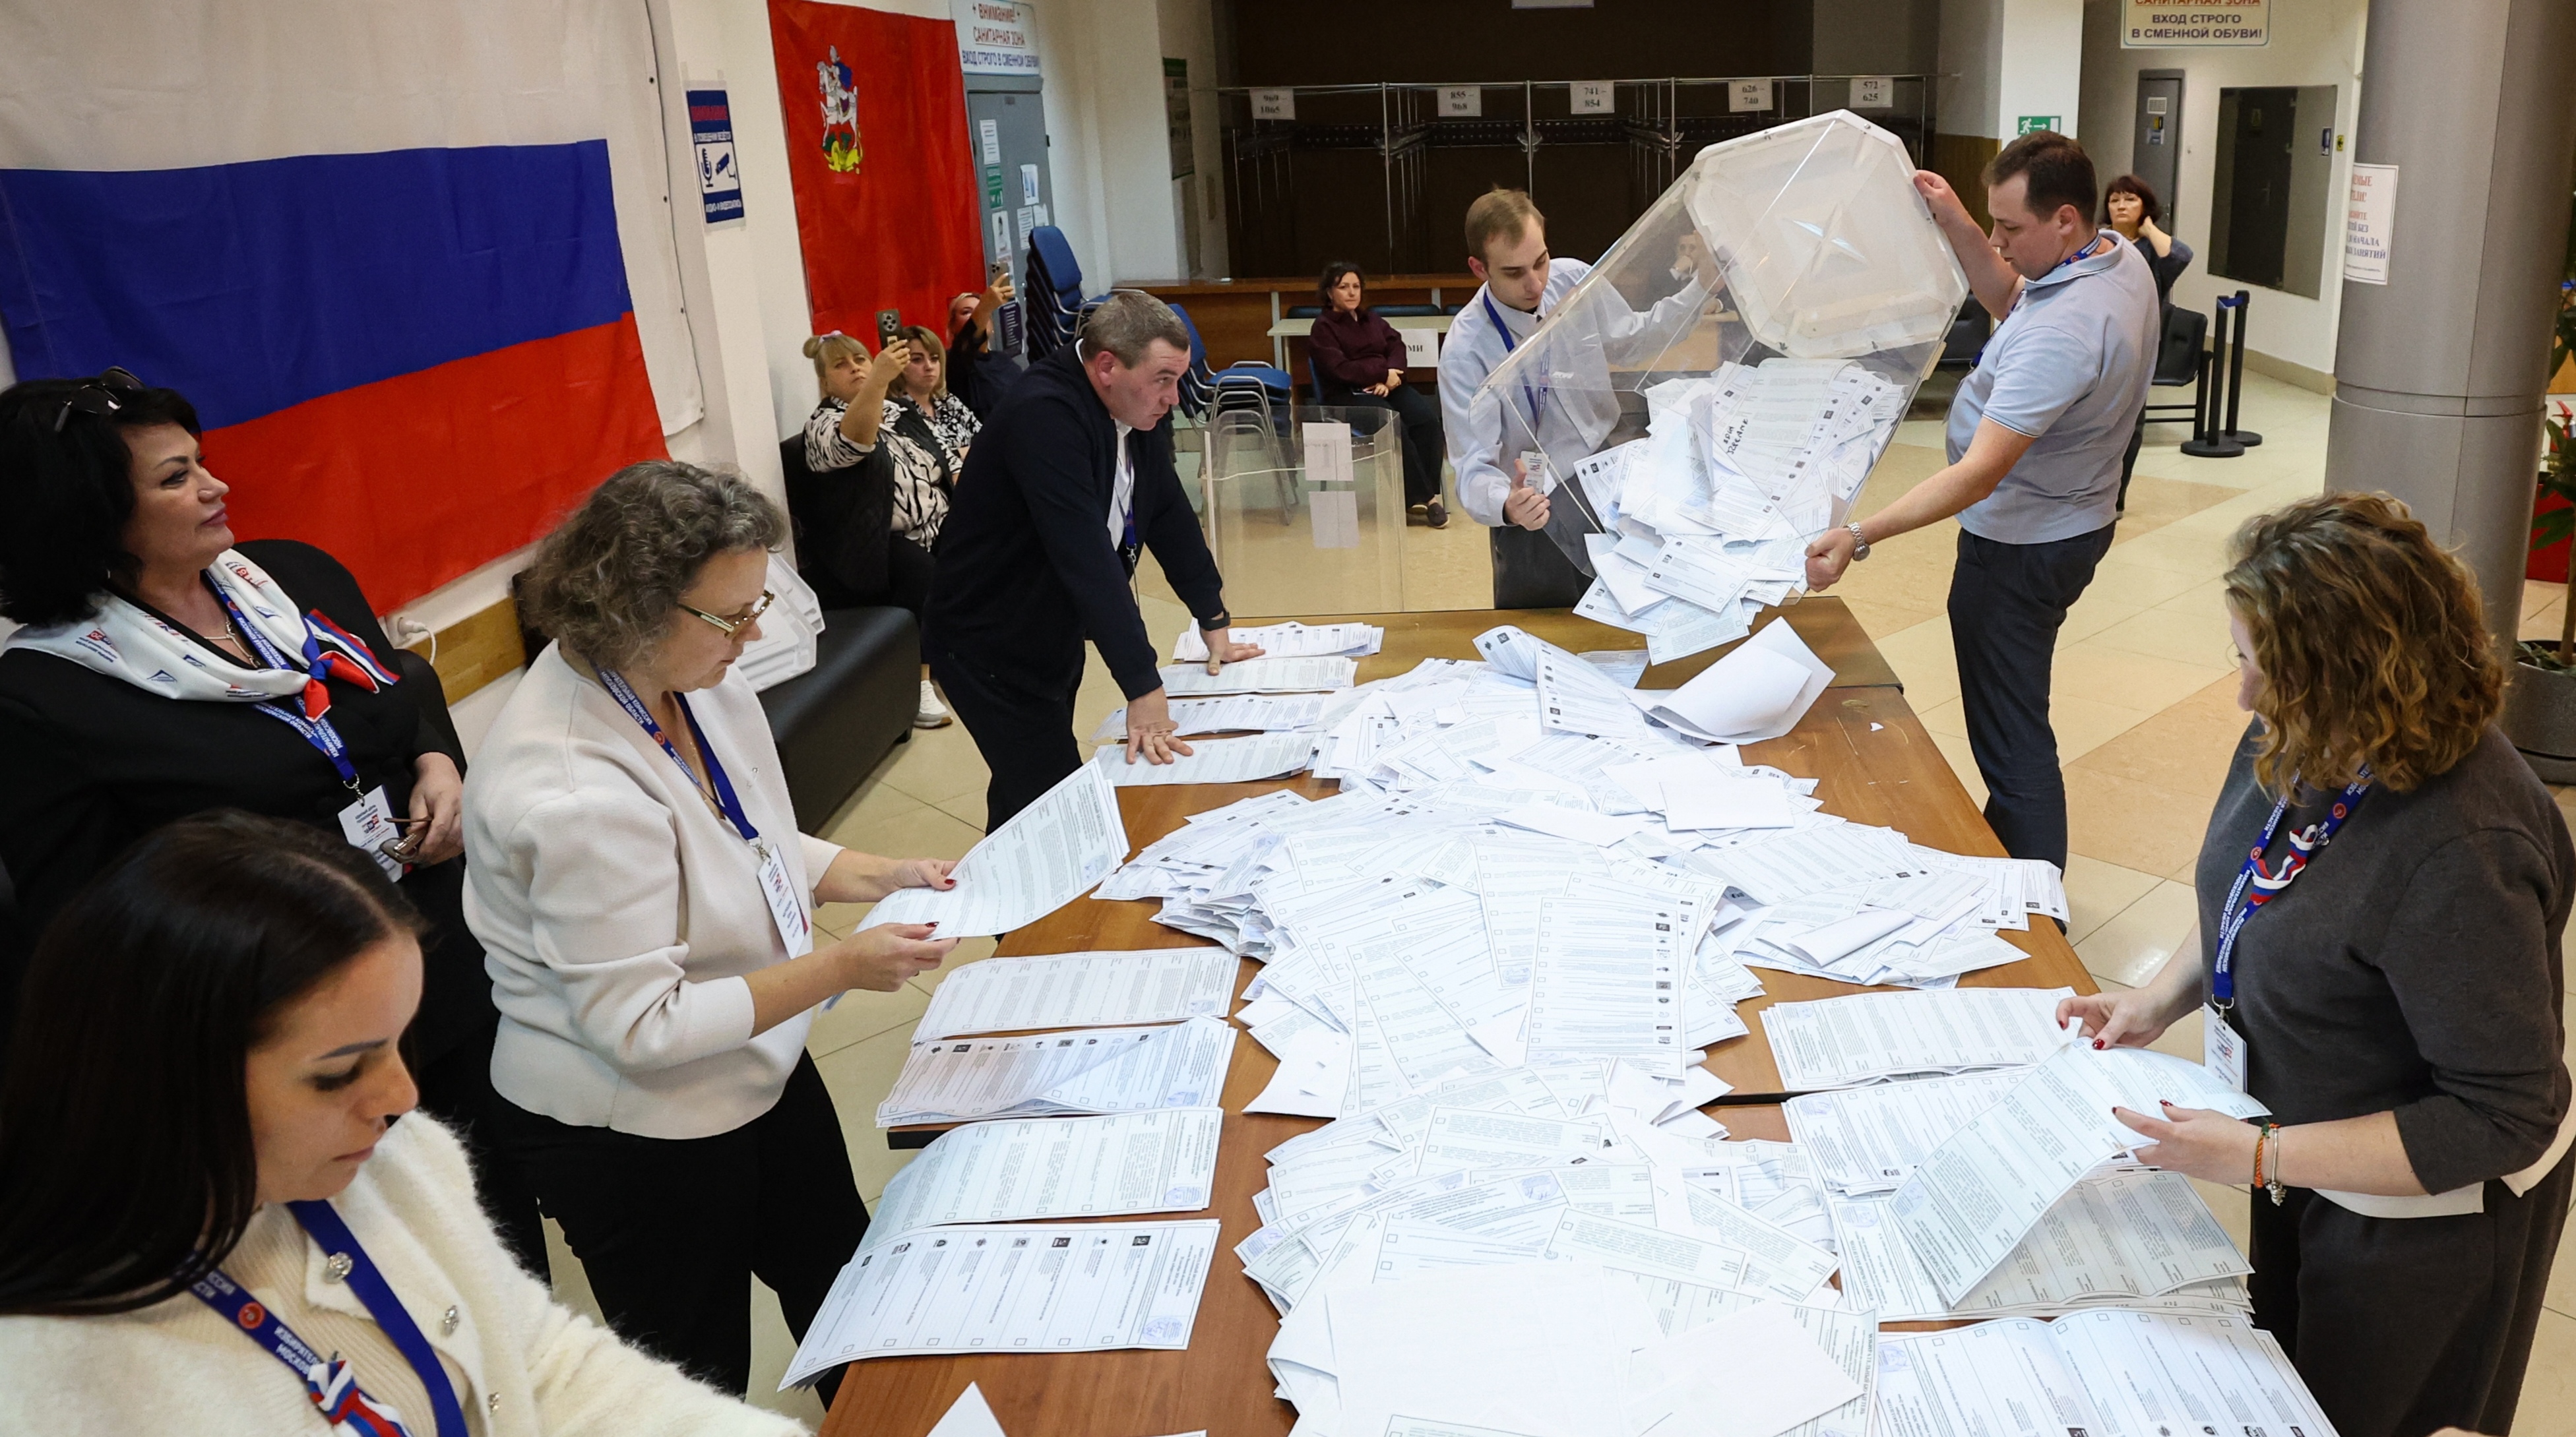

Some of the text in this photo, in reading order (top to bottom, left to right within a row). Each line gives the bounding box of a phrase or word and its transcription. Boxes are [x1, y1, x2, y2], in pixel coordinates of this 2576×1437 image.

[2152, 14, 2242, 24] ВХОД СТРОГО
[2132, 27, 2263, 38] В СМЕННОЙ ОБУВИ!
[978, 51, 997, 65] СТРОГО
[1862, 80, 1879, 89] 572
[1862, 93, 1879, 102] 625
[237, 616, 257, 640] КОМИССИЯ
[600, 671, 644, 725] МОСКОВСКОЙ ОБЛАСТИ
[631, 698, 653, 725] КОМИССИЯ
[289, 719, 312, 739] ОБЛАСТИ
[313, 722, 339, 758] ИЗБИРАТЕЛЬН
[319, 717, 343, 749] МОСКОВСКОЙ
[2263, 805, 2279, 831] ОБЛАСТИ
[2265, 808, 2282, 840] КОМИССИЯ
[2224, 873, 2243, 911] МОСКОВСКОЙ
[2227, 869, 2250, 915] ИЗБИРАТЕЛЬНАЯ
[2222, 917, 2245, 973] МОСКОВСКОЙ ОБЛАСТИ
